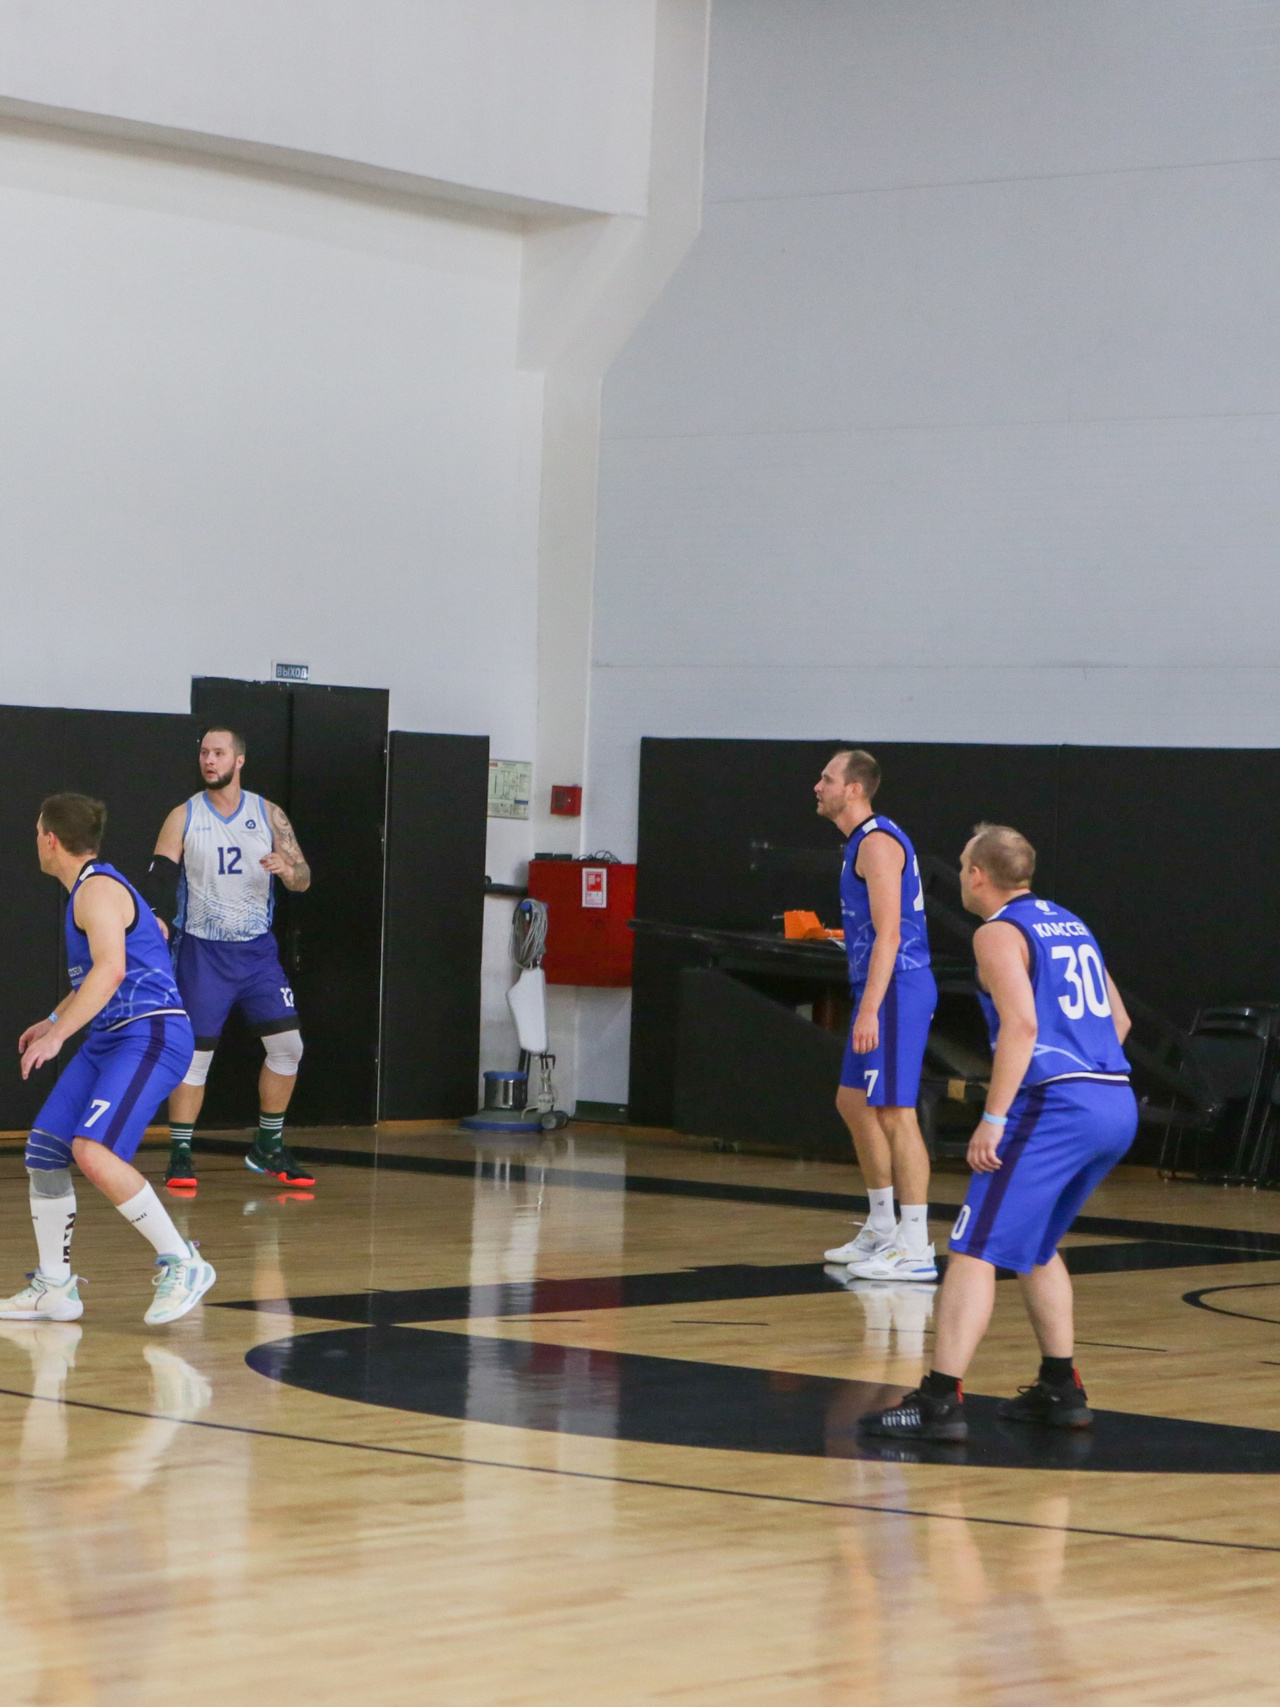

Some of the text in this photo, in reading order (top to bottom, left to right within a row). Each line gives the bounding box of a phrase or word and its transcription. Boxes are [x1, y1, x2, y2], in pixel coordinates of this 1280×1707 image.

[276, 665, 308, 680] ВЫХОД
[217, 846, 243, 875] 12
[1051, 944, 1111, 1020] 30
[863, 1068, 879, 1098] 7
[84, 1099, 112, 1128] 7
